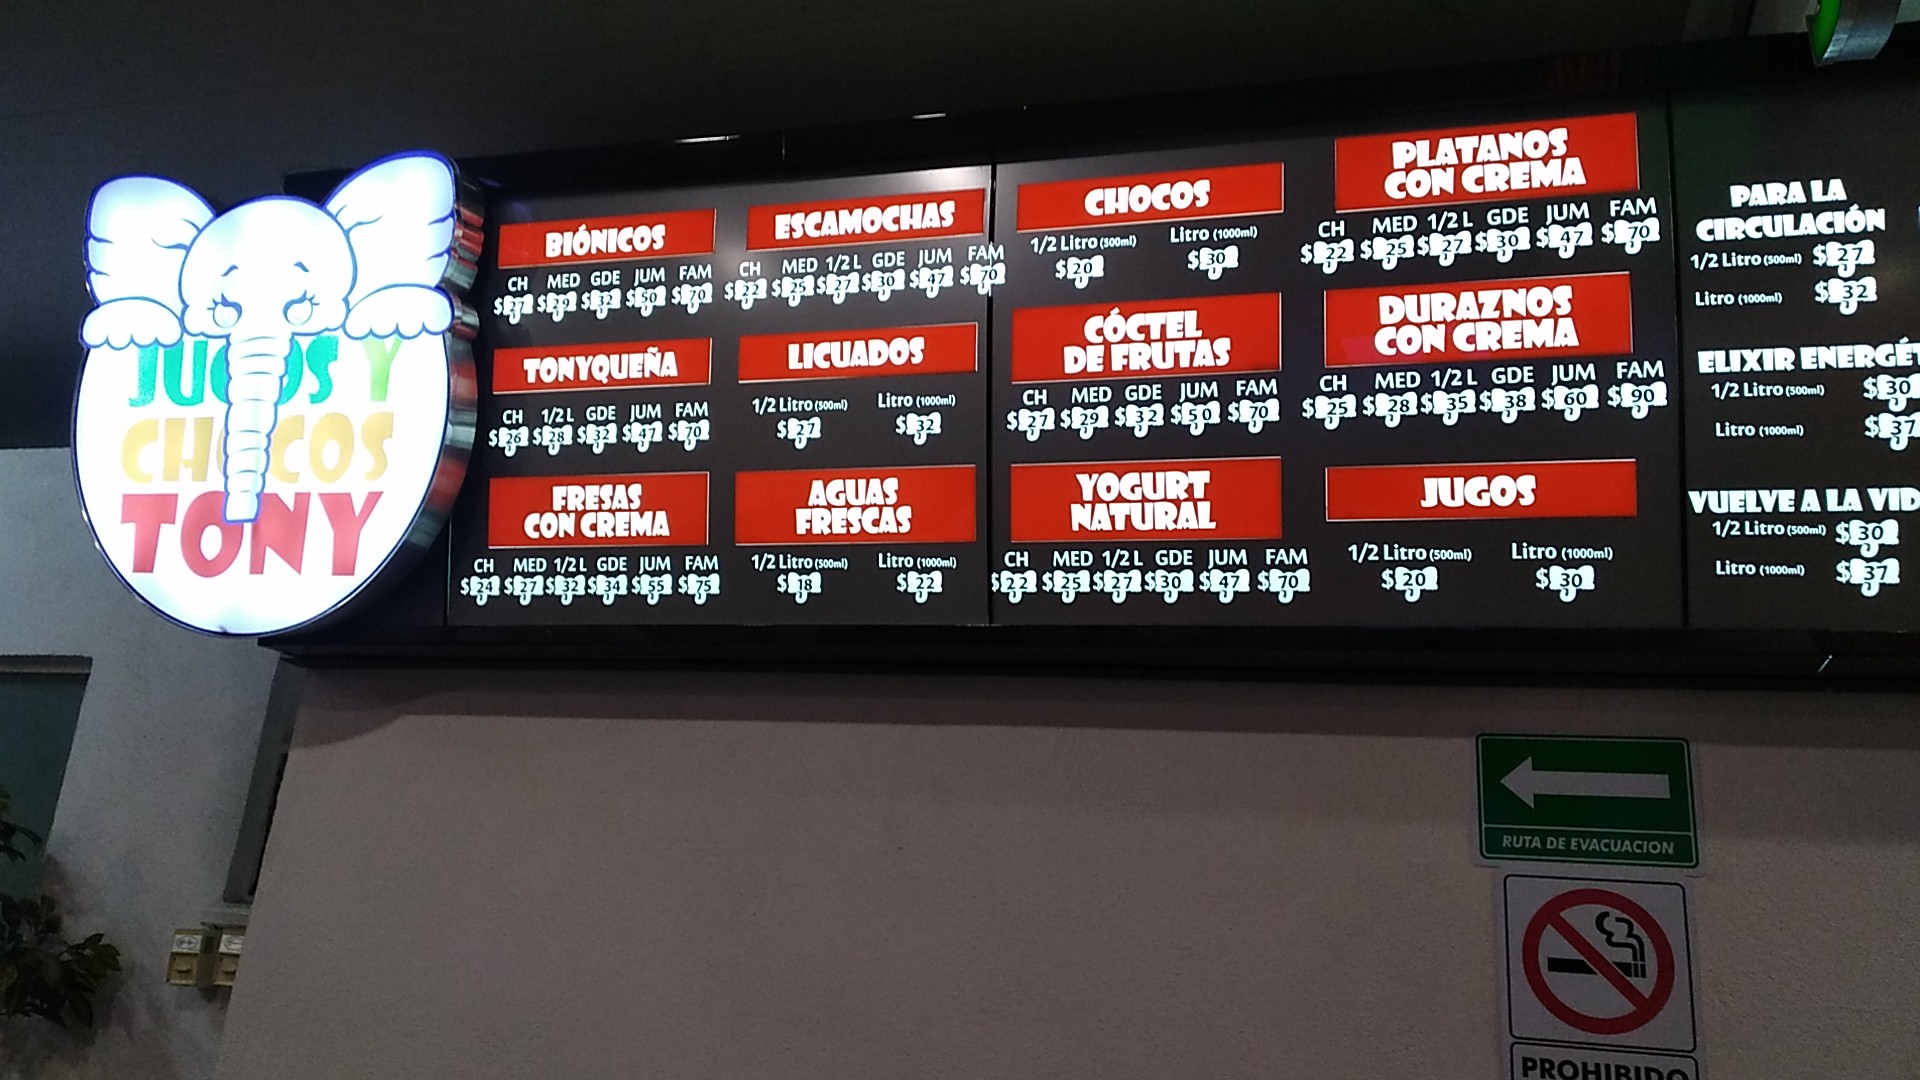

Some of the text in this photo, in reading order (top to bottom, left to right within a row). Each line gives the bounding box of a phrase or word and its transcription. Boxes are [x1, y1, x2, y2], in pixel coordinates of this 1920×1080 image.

[1392, 127, 1570, 171] PLATANOS
[1384, 155, 1587, 200] CON CREMA
[1084, 179, 1211, 217] CHOCOS
[1729, 178, 1848, 208] PARA LA
[774, 200, 957, 241] ESCAMOCHAS
[1318, 220, 1345, 238] CH
[1372, 215, 1418, 234] MED
[1427, 211, 1459, 232] 1/2
[1486, 206, 1529, 226] GDE
[1545, 201, 1590, 224] JUM
[1609, 196, 1657, 217] FAM
[1695, 202, 1886, 243] CIRCULACIÓN
[545, 223, 666, 259] BIÓNICOS
[1030, 234, 1137, 255] 1/2 Litro (500ml)
[1170, 225, 1258, 243] Litro (1000ml)
[737, 260, 762, 278] CH
[781, 257, 819, 275] MED
[825, 254, 851, 273] 1/2
[871, 251, 906, 269] GDE
[917, 247, 953, 268] JUM
[967, 244, 1005, 262] FAM
[1690, 252, 1719, 271] 1/2
[1721, 251, 1762, 268] Litro
[1763, 252, 1803, 267] (500ml)
[507, 263, 713, 292] CH MED GDE JUM FAM
[1378, 285, 1574, 326] DURAZNOS
[1695, 290, 1735, 306] Litro
[1737, 291, 1783, 306] (1000ml)
[1083, 306, 1203, 345] CÓCTEL
[1374, 316, 1580, 356] CON CREMA
[523, 346, 679, 385] TONYQUEÑA
[788, 336, 925, 370] LICUADOS
[1063, 335, 1231, 374] DE FRUTAS
[1697, 347, 1796, 374] ELIXIR
[361, 337, 402, 402] Y
[1319, 374, 1347, 392] CH
[1374, 371, 1421, 390] MED
[1430, 367, 1463, 389] 1/2
[1491, 365, 1535, 385] GDE
[1551, 363, 1597, 387] JUM
[1616, 360, 1665, 380] FAM
[877, 392, 956, 409] Litro (1000ml)
[1022, 378, 1278, 406] CH MED GDE JUM FAM
[1710, 381, 1740, 400] 1/2
[1743, 381, 1784, 397] Litro
[1785, 384, 1825, 398] (500ml)
[502, 409, 523, 425] CH
[541, 406, 564, 424] 1/2
[585, 405, 616, 422] GDE
[629, 403, 662, 423] JUM
[675, 401, 709, 418] FAM
[751, 396, 848, 416] 1/2 Litro (500ml)
[1715, 421, 1756, 437] Litro
[1758, 424, 1804, 438] (1000ml)
[121, 411, 395, 484] CHCOS
[552, 483, 643, 512] FRESAS
[807, 477, 899, 507] AGUAS
[1075, 470, 1211, 503] YOGURT
[1420, 474, 1537, 508] JUGOS
[1687, 487, 1920, 514] VUELVE A LA VID
[523, 509, 670, 539] CON CREMA
[795, 504, 912, 536] FRESCAS
[1070, 500, 1217, 532] NATURAL
[1712, 519, 1741, 538] 1/2
[1744, 520, 1786, 536] Litro
[1786, 524, 1827, 537] (500ml)
[121, 490, 384, 578] TONY
[473, 558, 494, 573] CH
[513, 557, 547, 573] MED
[553, 555, 577, 574] 1/2
[596, 556, 628, 572] GDE
[638, 555, 671, 574] JUM
[685, 555, 719, 571] FAM
[751, 553, 849, 572] 1/2 Litro (500ml)
[878, 552, 957, 570] Litro (1000ml)
[1004, 551, 1029, 568] CH
[1052, 550, 1094, 567] MED
[1101, 548, 1130, 568] 1/2
[1155, 549, 1194, 566] GDE
[1207, 548, 1248, 569] JUM
[1265, 548, 1308, 565] FAM
[1347, 542, 1472, 564] 1/2 Litro (500ml)
[1511, 541, 1614, 561] Litro (1000ml)
[1715, 559, 1757, 575] Litro
[1759, 564, 1805, 577] (1000ml)
[1502, 834, 1675, 855] RUTA DE EVACUACION
